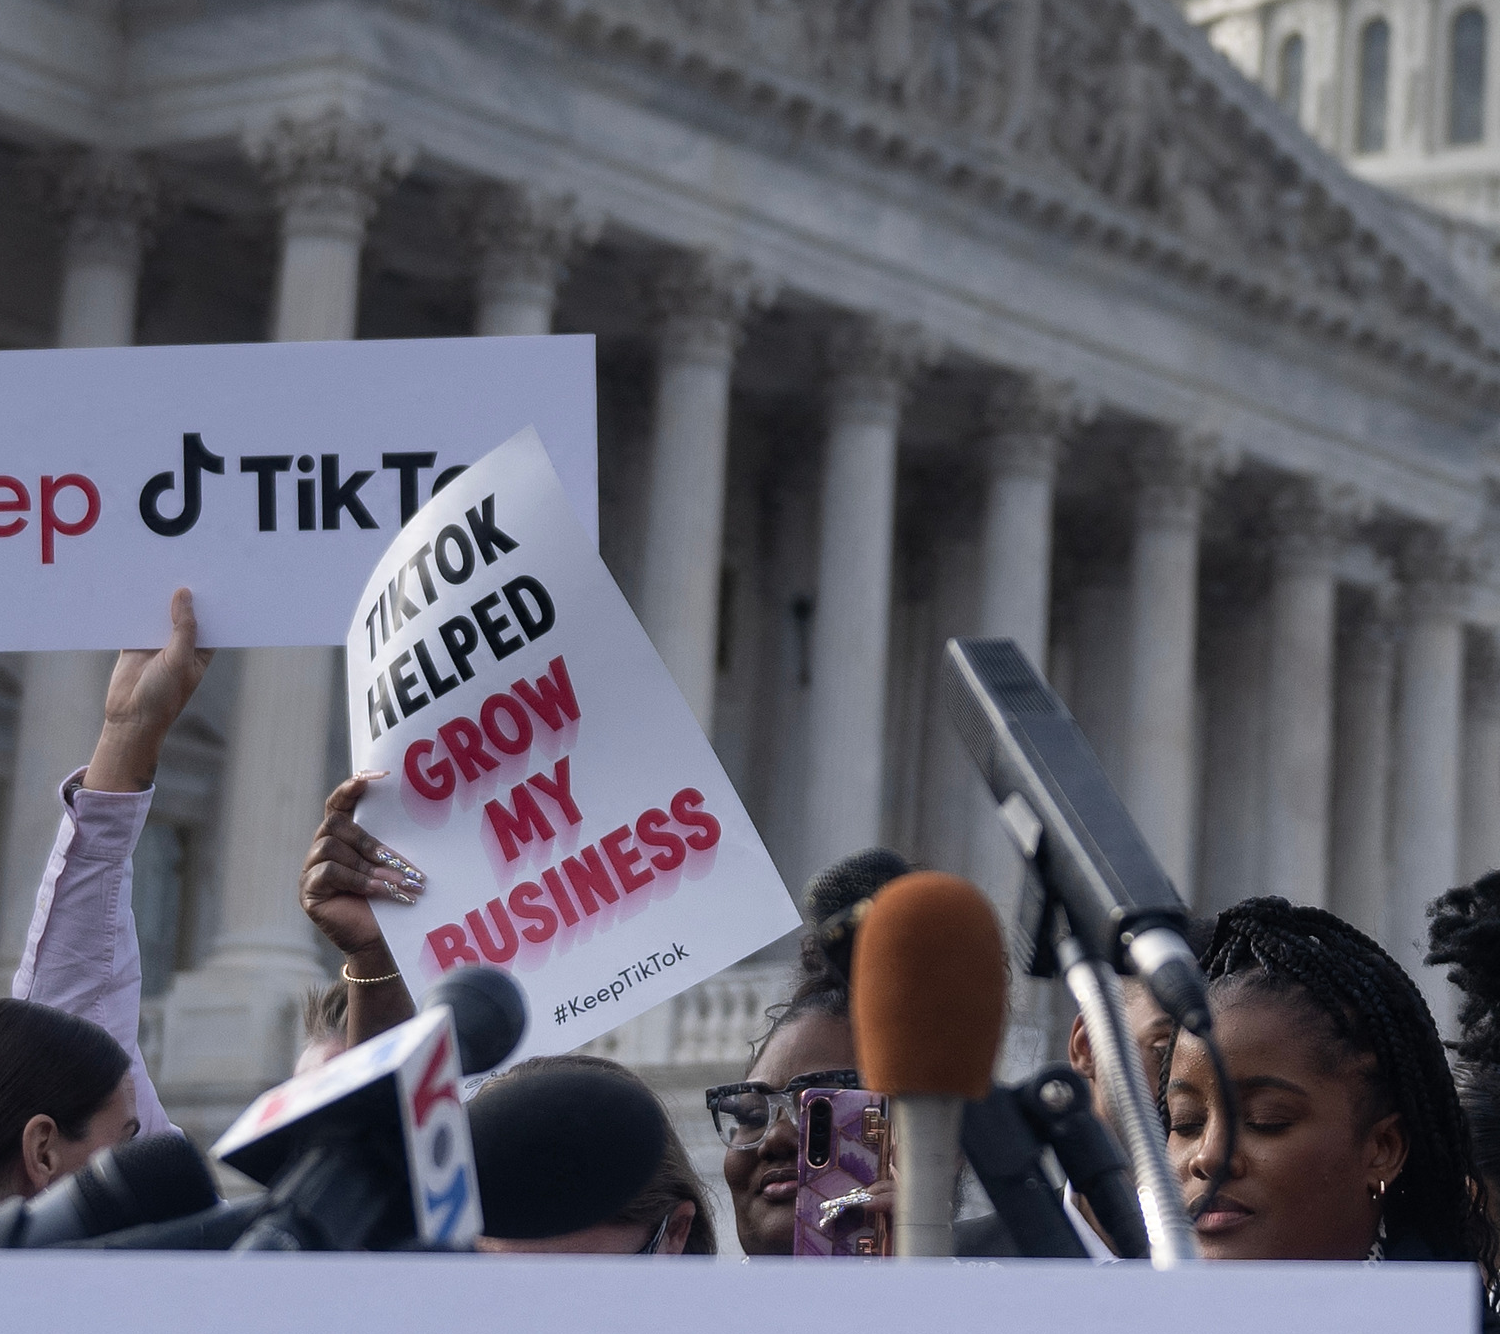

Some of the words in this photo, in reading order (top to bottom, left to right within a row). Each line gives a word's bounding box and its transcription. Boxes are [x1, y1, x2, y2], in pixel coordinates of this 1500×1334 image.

[241, 451, 472, 531] TikT
[367, 495, 519, 656] TIKTOK
[367, 576, 555, 741] HELPED
[404, 659, 578, 801] GROW
[428, 790, 719, 969] BUSINESS
[486, 761, 579, 861] MY
[555, 943, 689, 1024] #KeepTikTok
